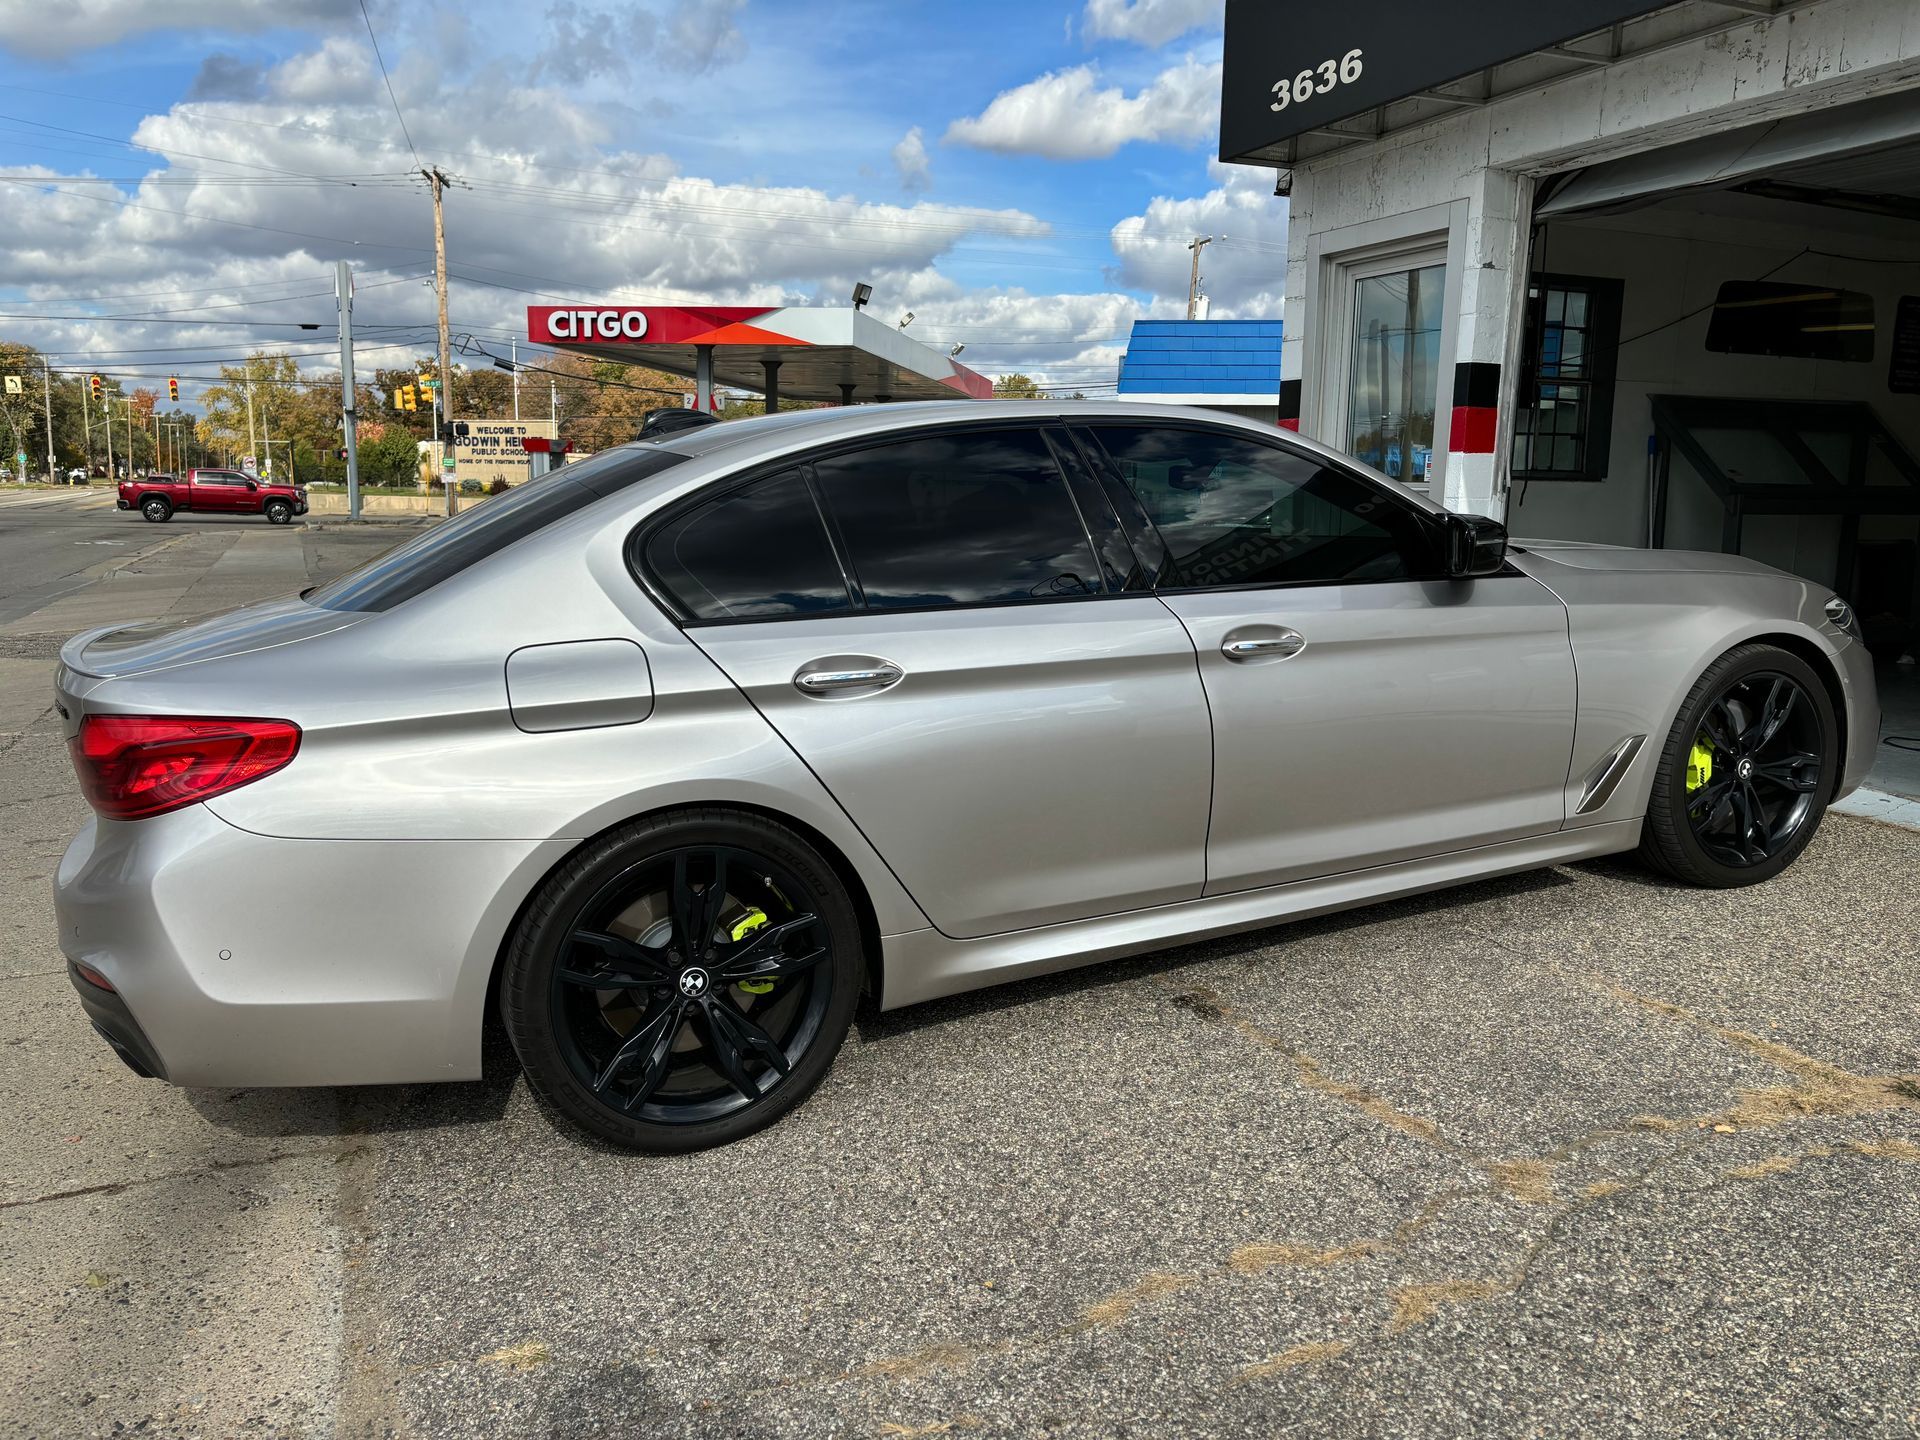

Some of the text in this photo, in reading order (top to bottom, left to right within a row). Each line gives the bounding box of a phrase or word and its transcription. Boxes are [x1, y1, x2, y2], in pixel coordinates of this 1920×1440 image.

[1270, 48, 1363, 112] 3636
[547, 310, 648, 338] CITGO
[476, 426, 527, 435] WELCOME TO
[454, 436, 543, 447] GODWIN HEIG
[471, 448, 497, 456] PUBLIC
